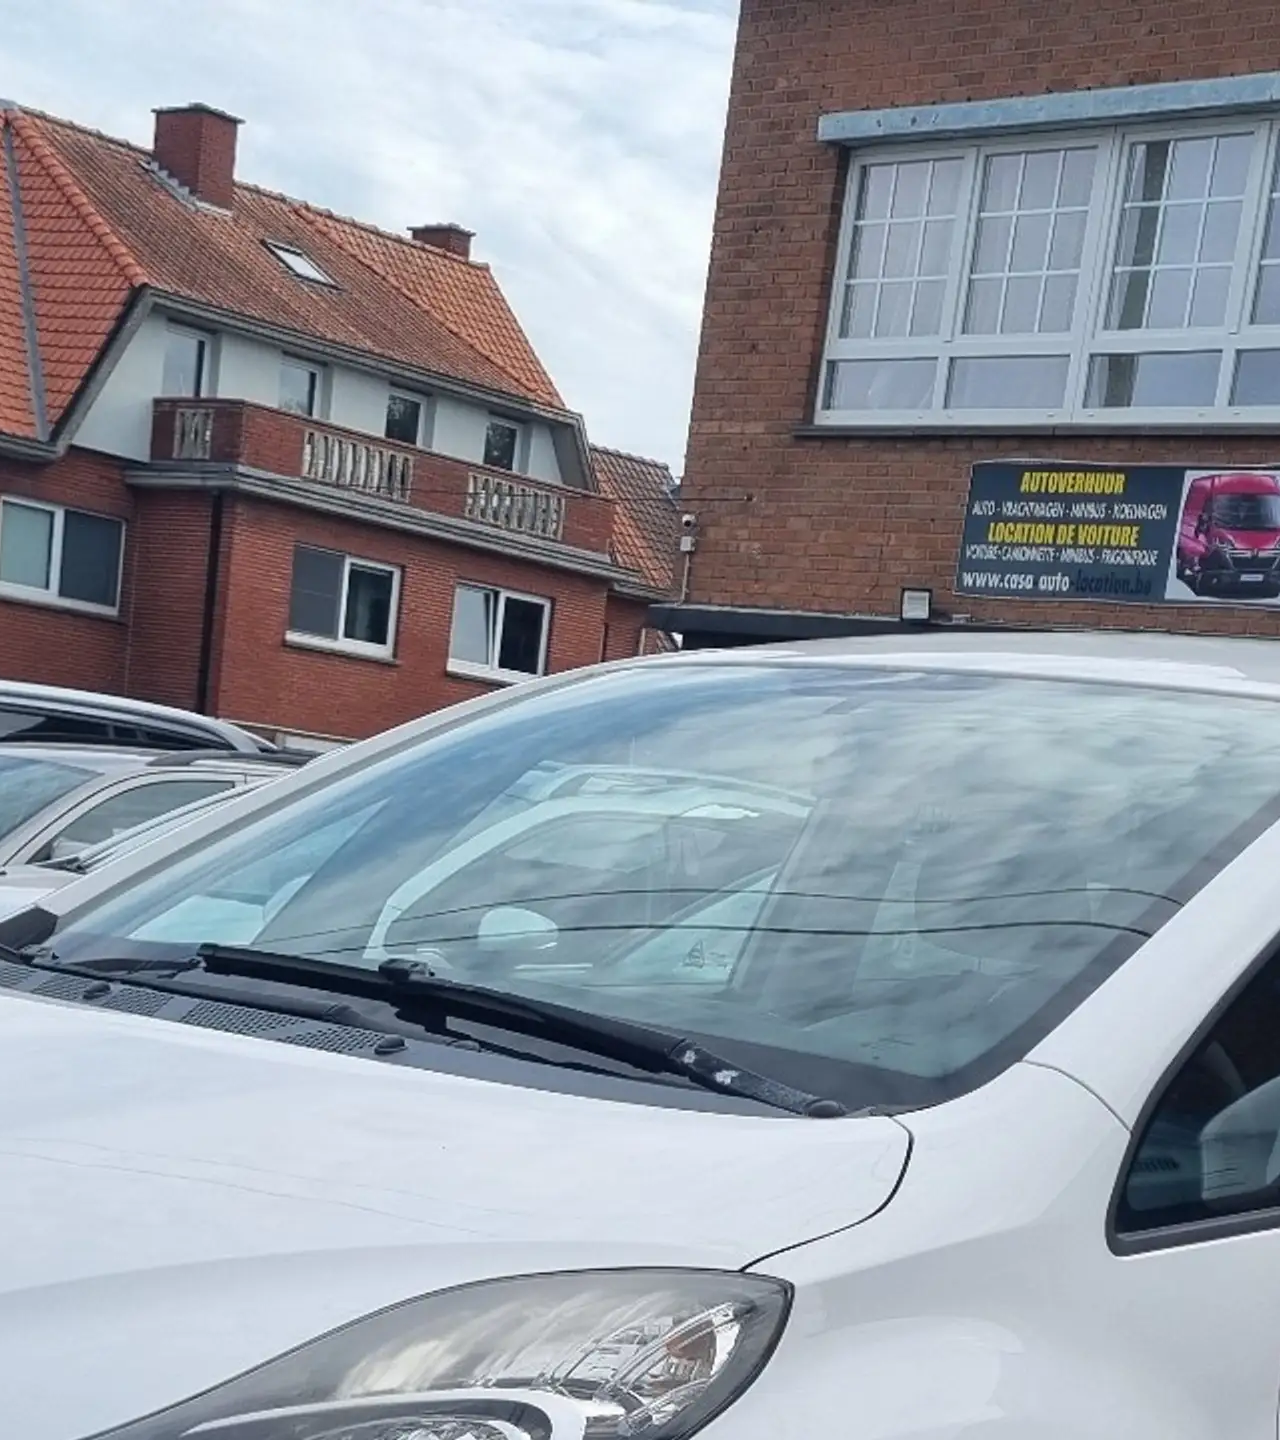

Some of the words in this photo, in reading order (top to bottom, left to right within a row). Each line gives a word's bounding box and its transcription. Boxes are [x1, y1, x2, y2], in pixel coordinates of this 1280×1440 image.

[1019, 471, 1126, 495] AUTOVERHUUR
[987, 521, 1056, 544] LOCATION
[1056, 523, 1076, 545] DE
[1077, 524, 1141, 547] VOITURE
